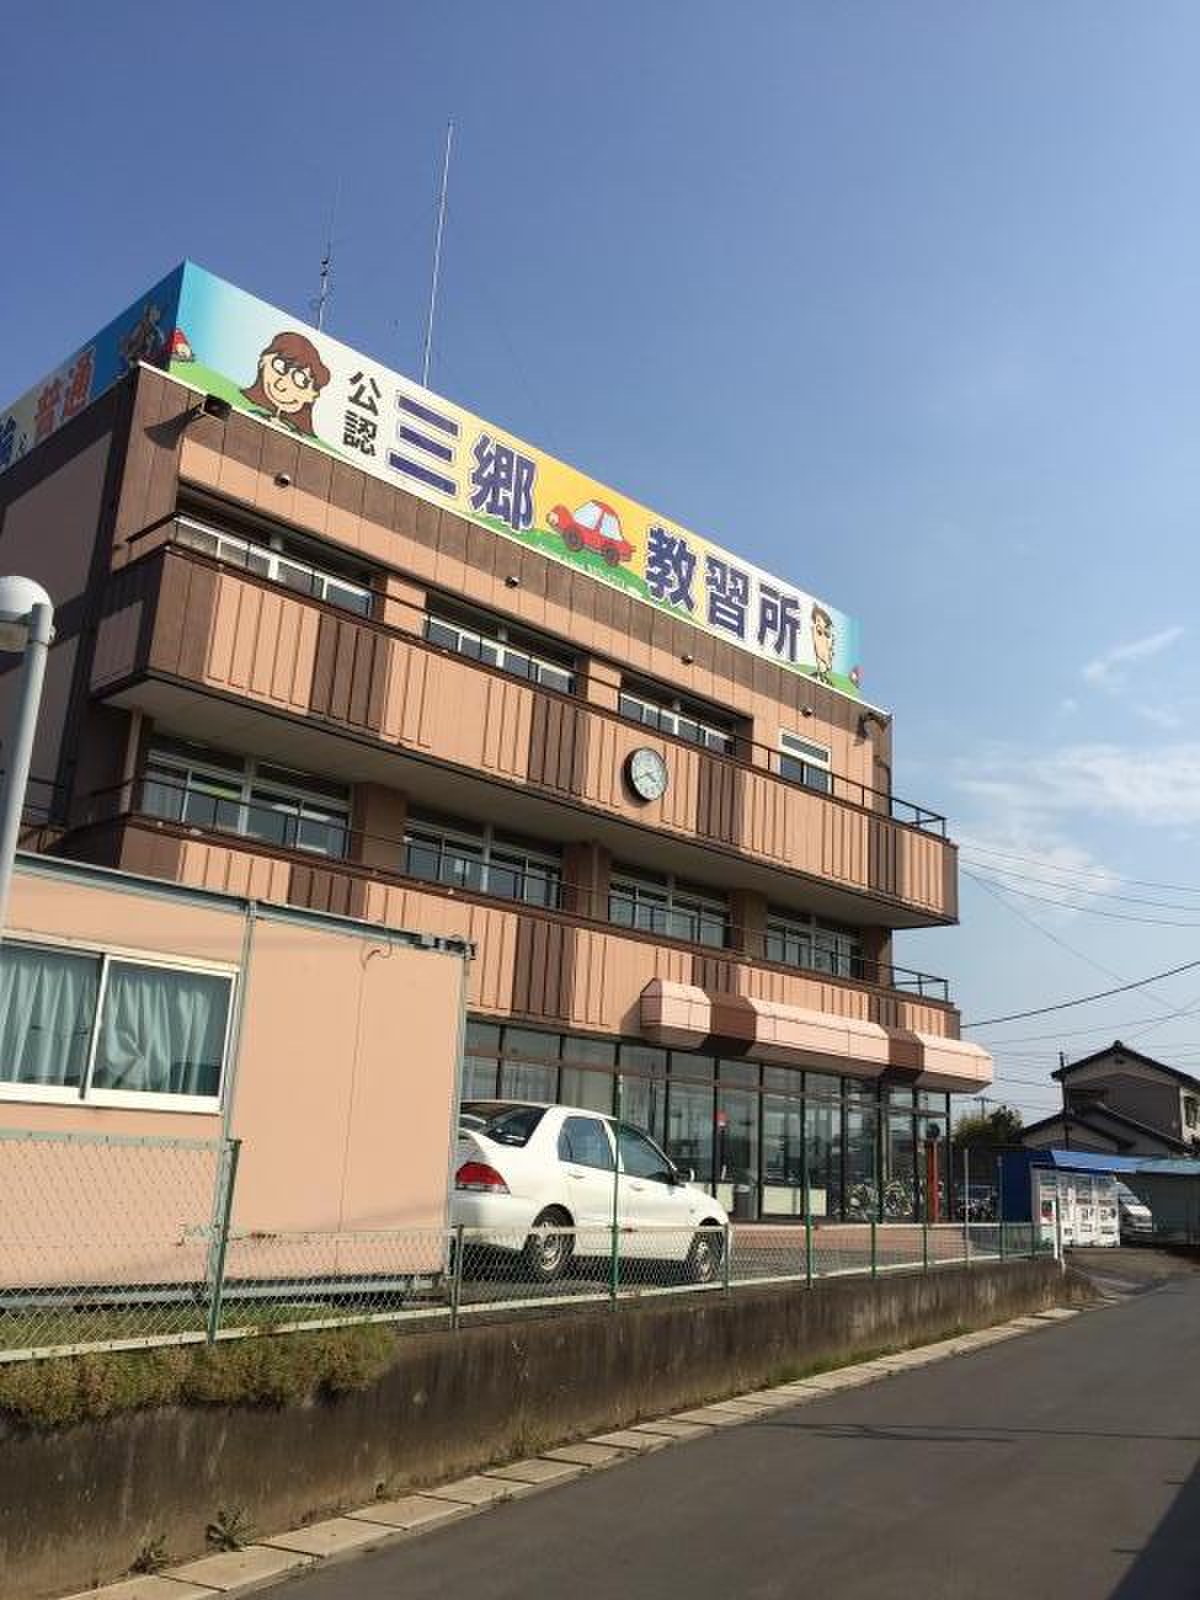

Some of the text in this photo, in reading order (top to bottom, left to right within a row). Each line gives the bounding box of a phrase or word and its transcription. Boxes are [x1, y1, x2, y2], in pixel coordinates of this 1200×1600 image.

[343, 371, 381, 457] 公認
[389, 395, 535, 531] 三郷
[646, 526, 801, 662] 教習所
